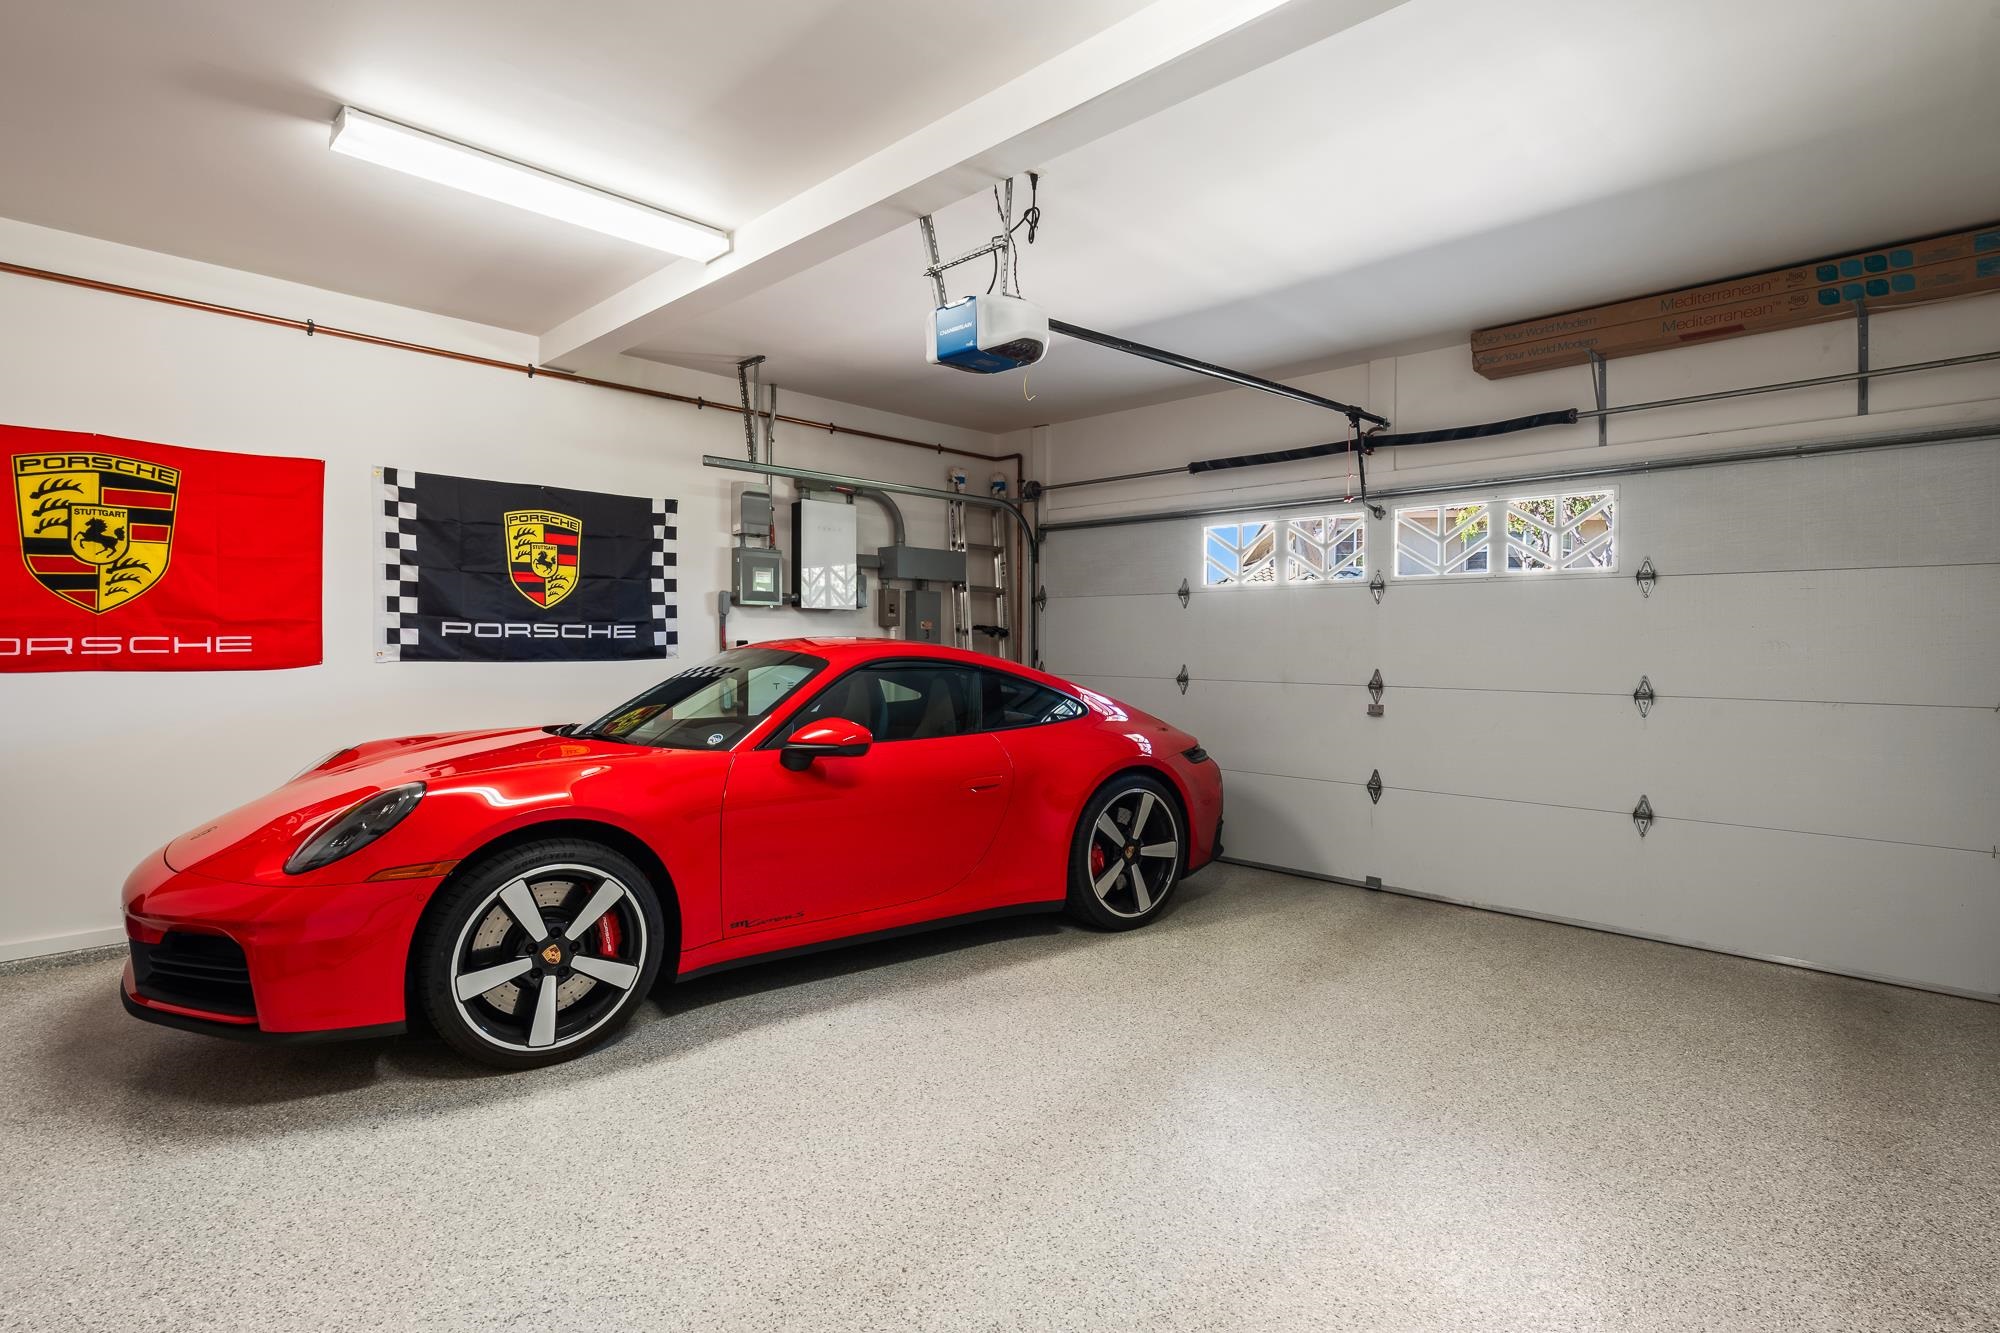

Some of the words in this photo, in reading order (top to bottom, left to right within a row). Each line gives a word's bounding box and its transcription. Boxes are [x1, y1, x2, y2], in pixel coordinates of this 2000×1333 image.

[20, 455, 176, 484] PORSCHE
[73, 507, 127, 518] STUTTGART
[509, 514, 578, 531] PORSCHE
[441, 621, 636, 639] PORSCHE
